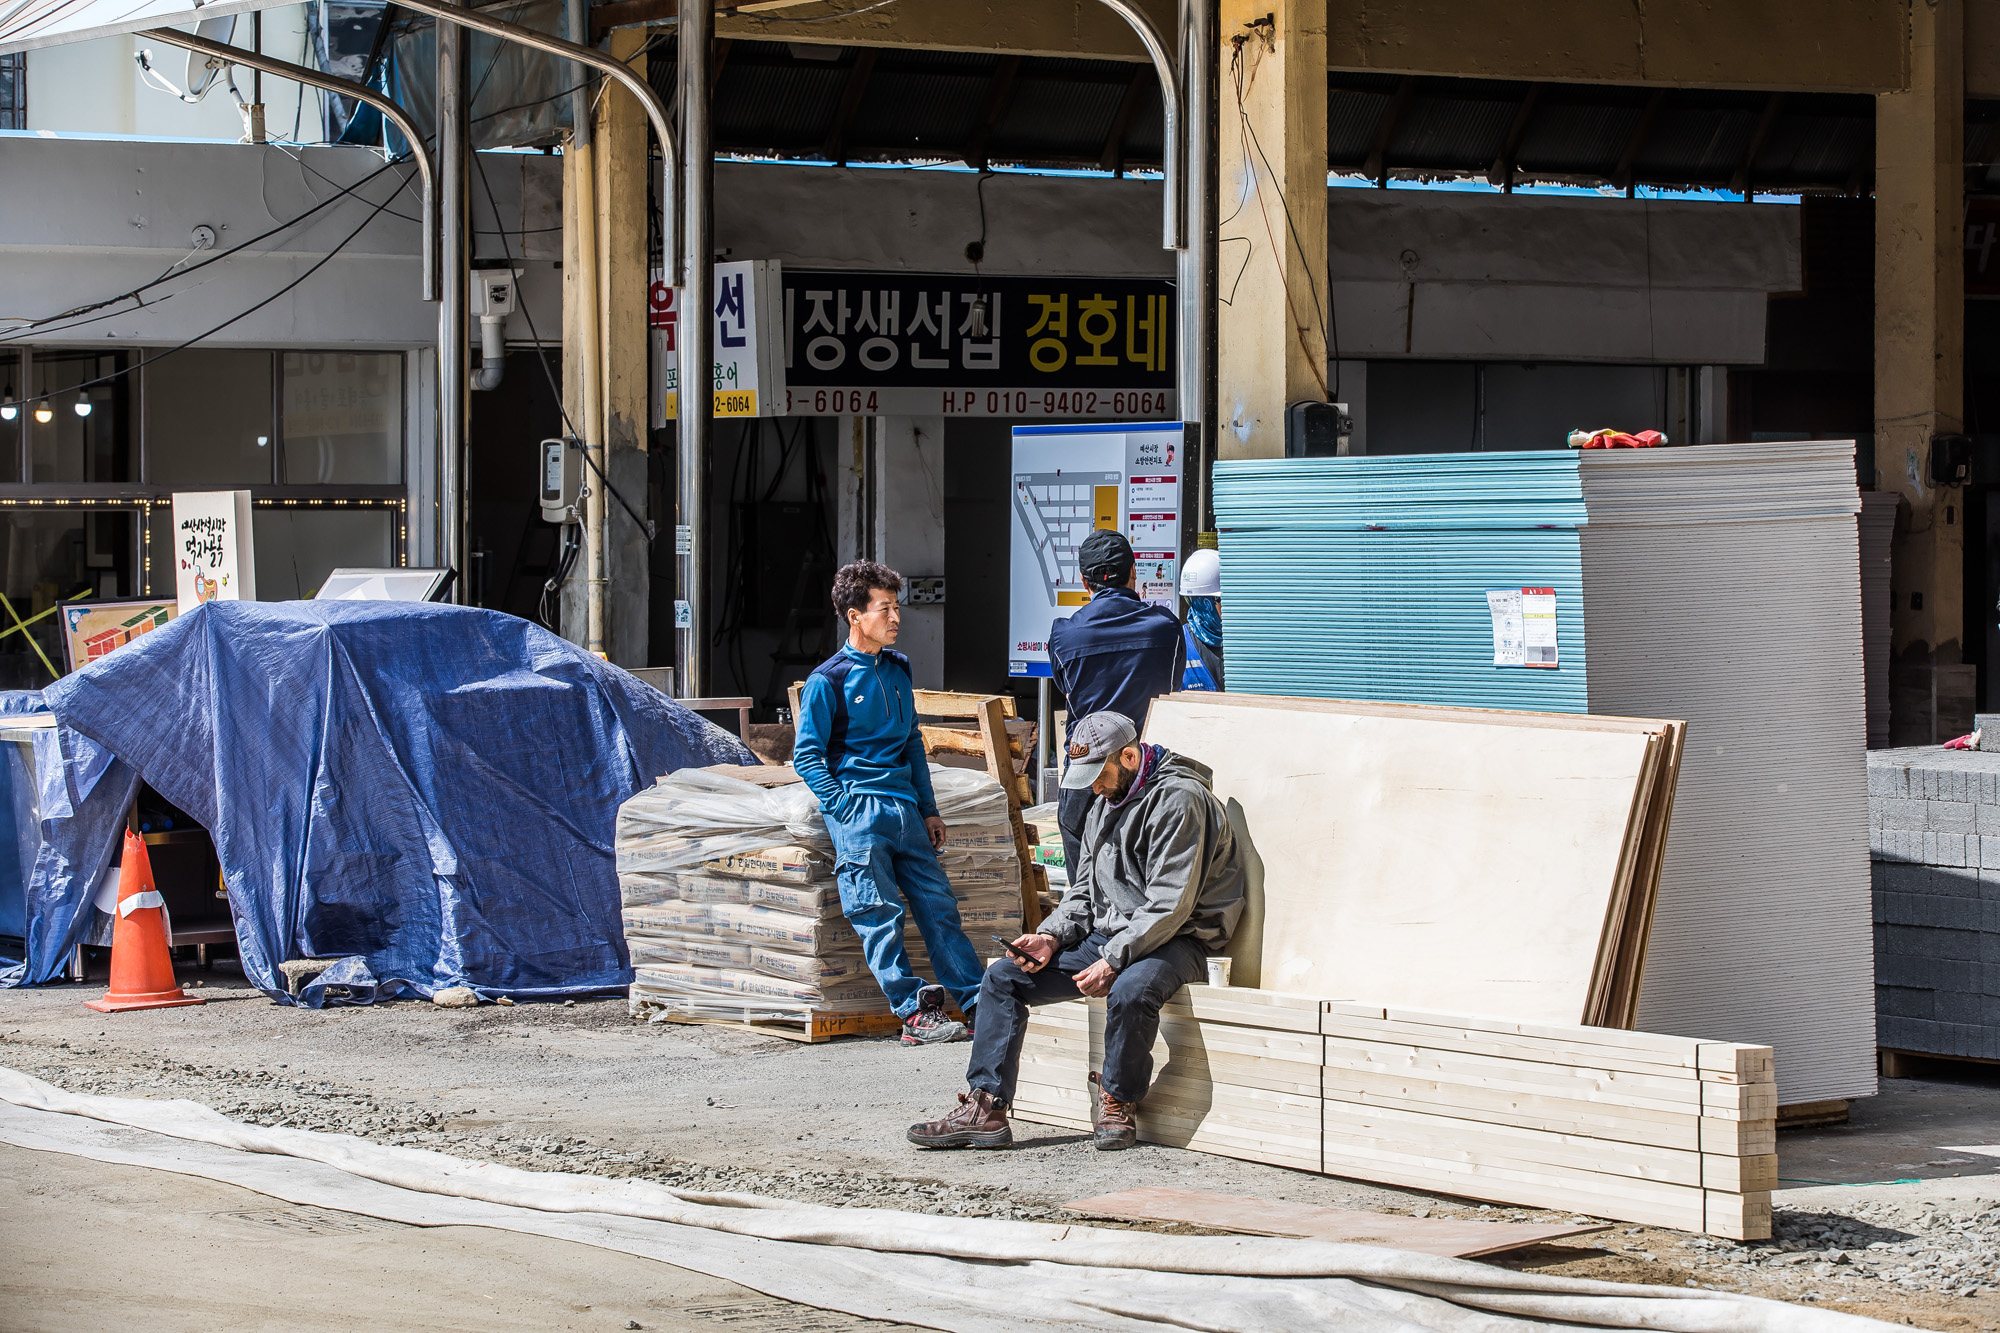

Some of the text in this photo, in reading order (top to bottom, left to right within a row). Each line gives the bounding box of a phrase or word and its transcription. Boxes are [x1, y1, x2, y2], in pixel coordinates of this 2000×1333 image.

[1025, 292, 1167, 373] 경호네
[942, 390, 977, 415] H.P
[986, 389, 1167, 416] 010-9402-6064
[1043, 848, 1054, 858] SP
[737, 857, 778, 872] 한일현대시멘트
[746, 924, 788, 941] 한일현대시멘트
[819, 1015, 847, 1033] KPP
